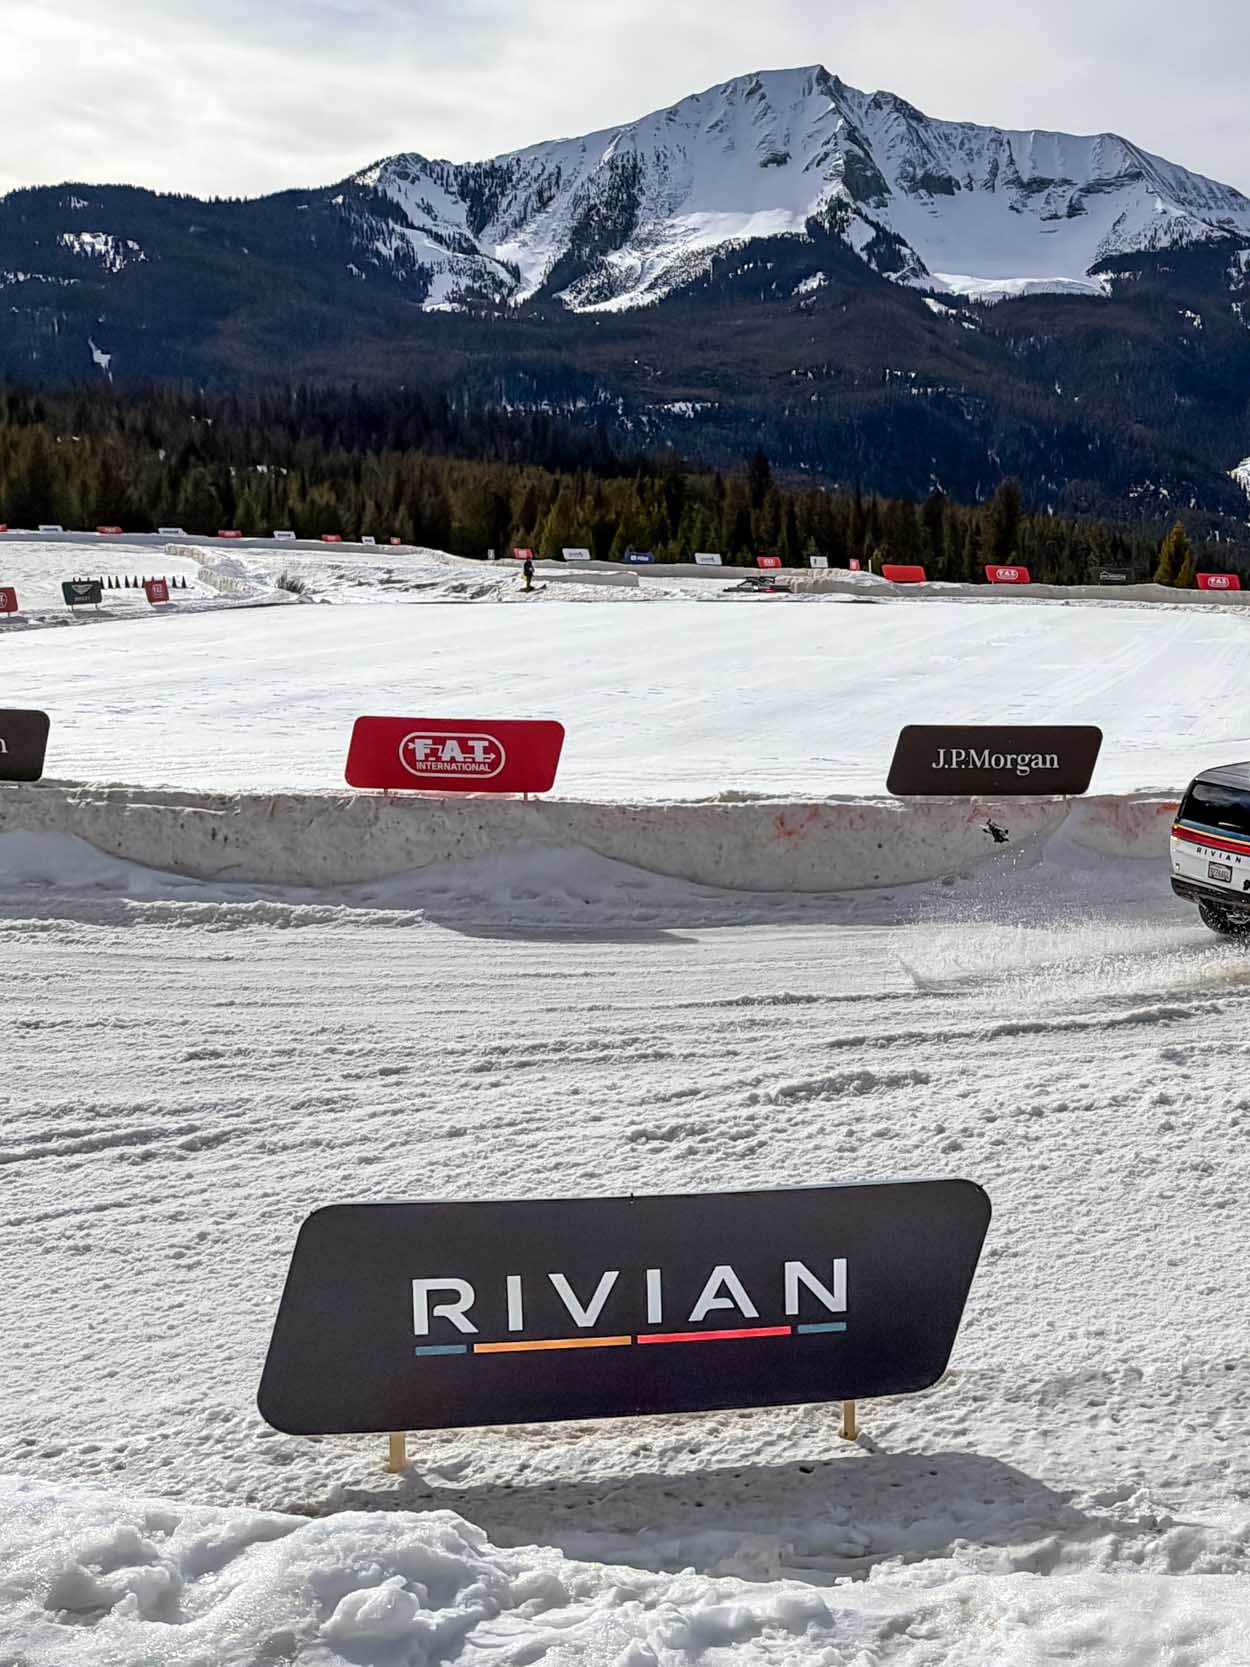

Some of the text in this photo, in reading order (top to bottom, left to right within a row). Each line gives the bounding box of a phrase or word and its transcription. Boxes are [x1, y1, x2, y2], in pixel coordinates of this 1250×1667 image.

[416, 761, 491, 772] INTERNATIONAL
[931, 749, 1060, 776] J.P.Morgan
[1196, 846, 1242, 863] RIVIAN
[412, 1258, 848, 1336] RIVIAN
